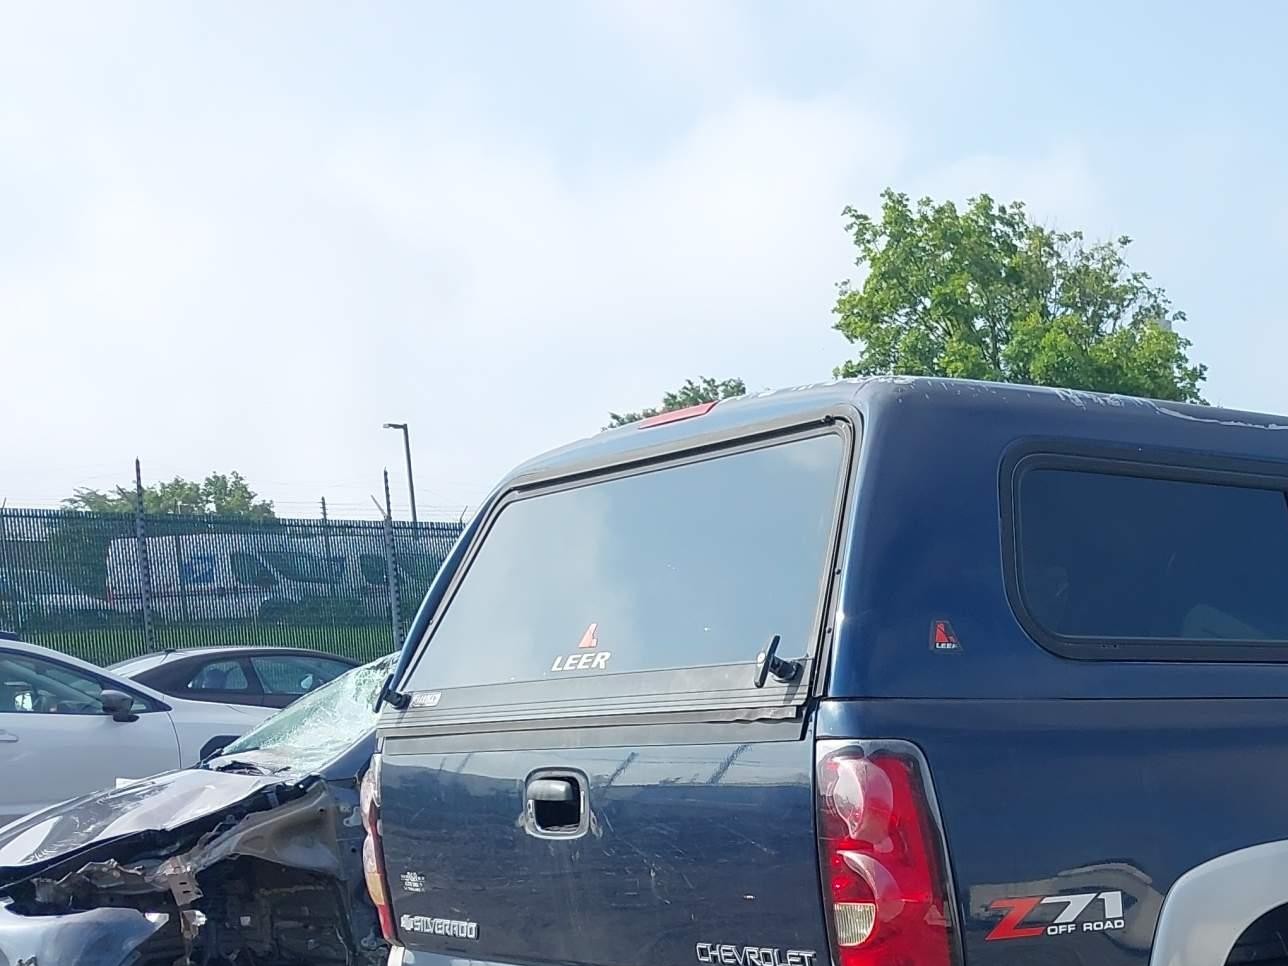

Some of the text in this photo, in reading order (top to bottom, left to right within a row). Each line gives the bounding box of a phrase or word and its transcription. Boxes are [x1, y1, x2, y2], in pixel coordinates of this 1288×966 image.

[551, 651, 611, 671] LEER
[985, 890, 1123, 941] Z71
[413, 915, 479, 939] SILVERADO
[1047, 918, 1124, 936] OFF ROAD
